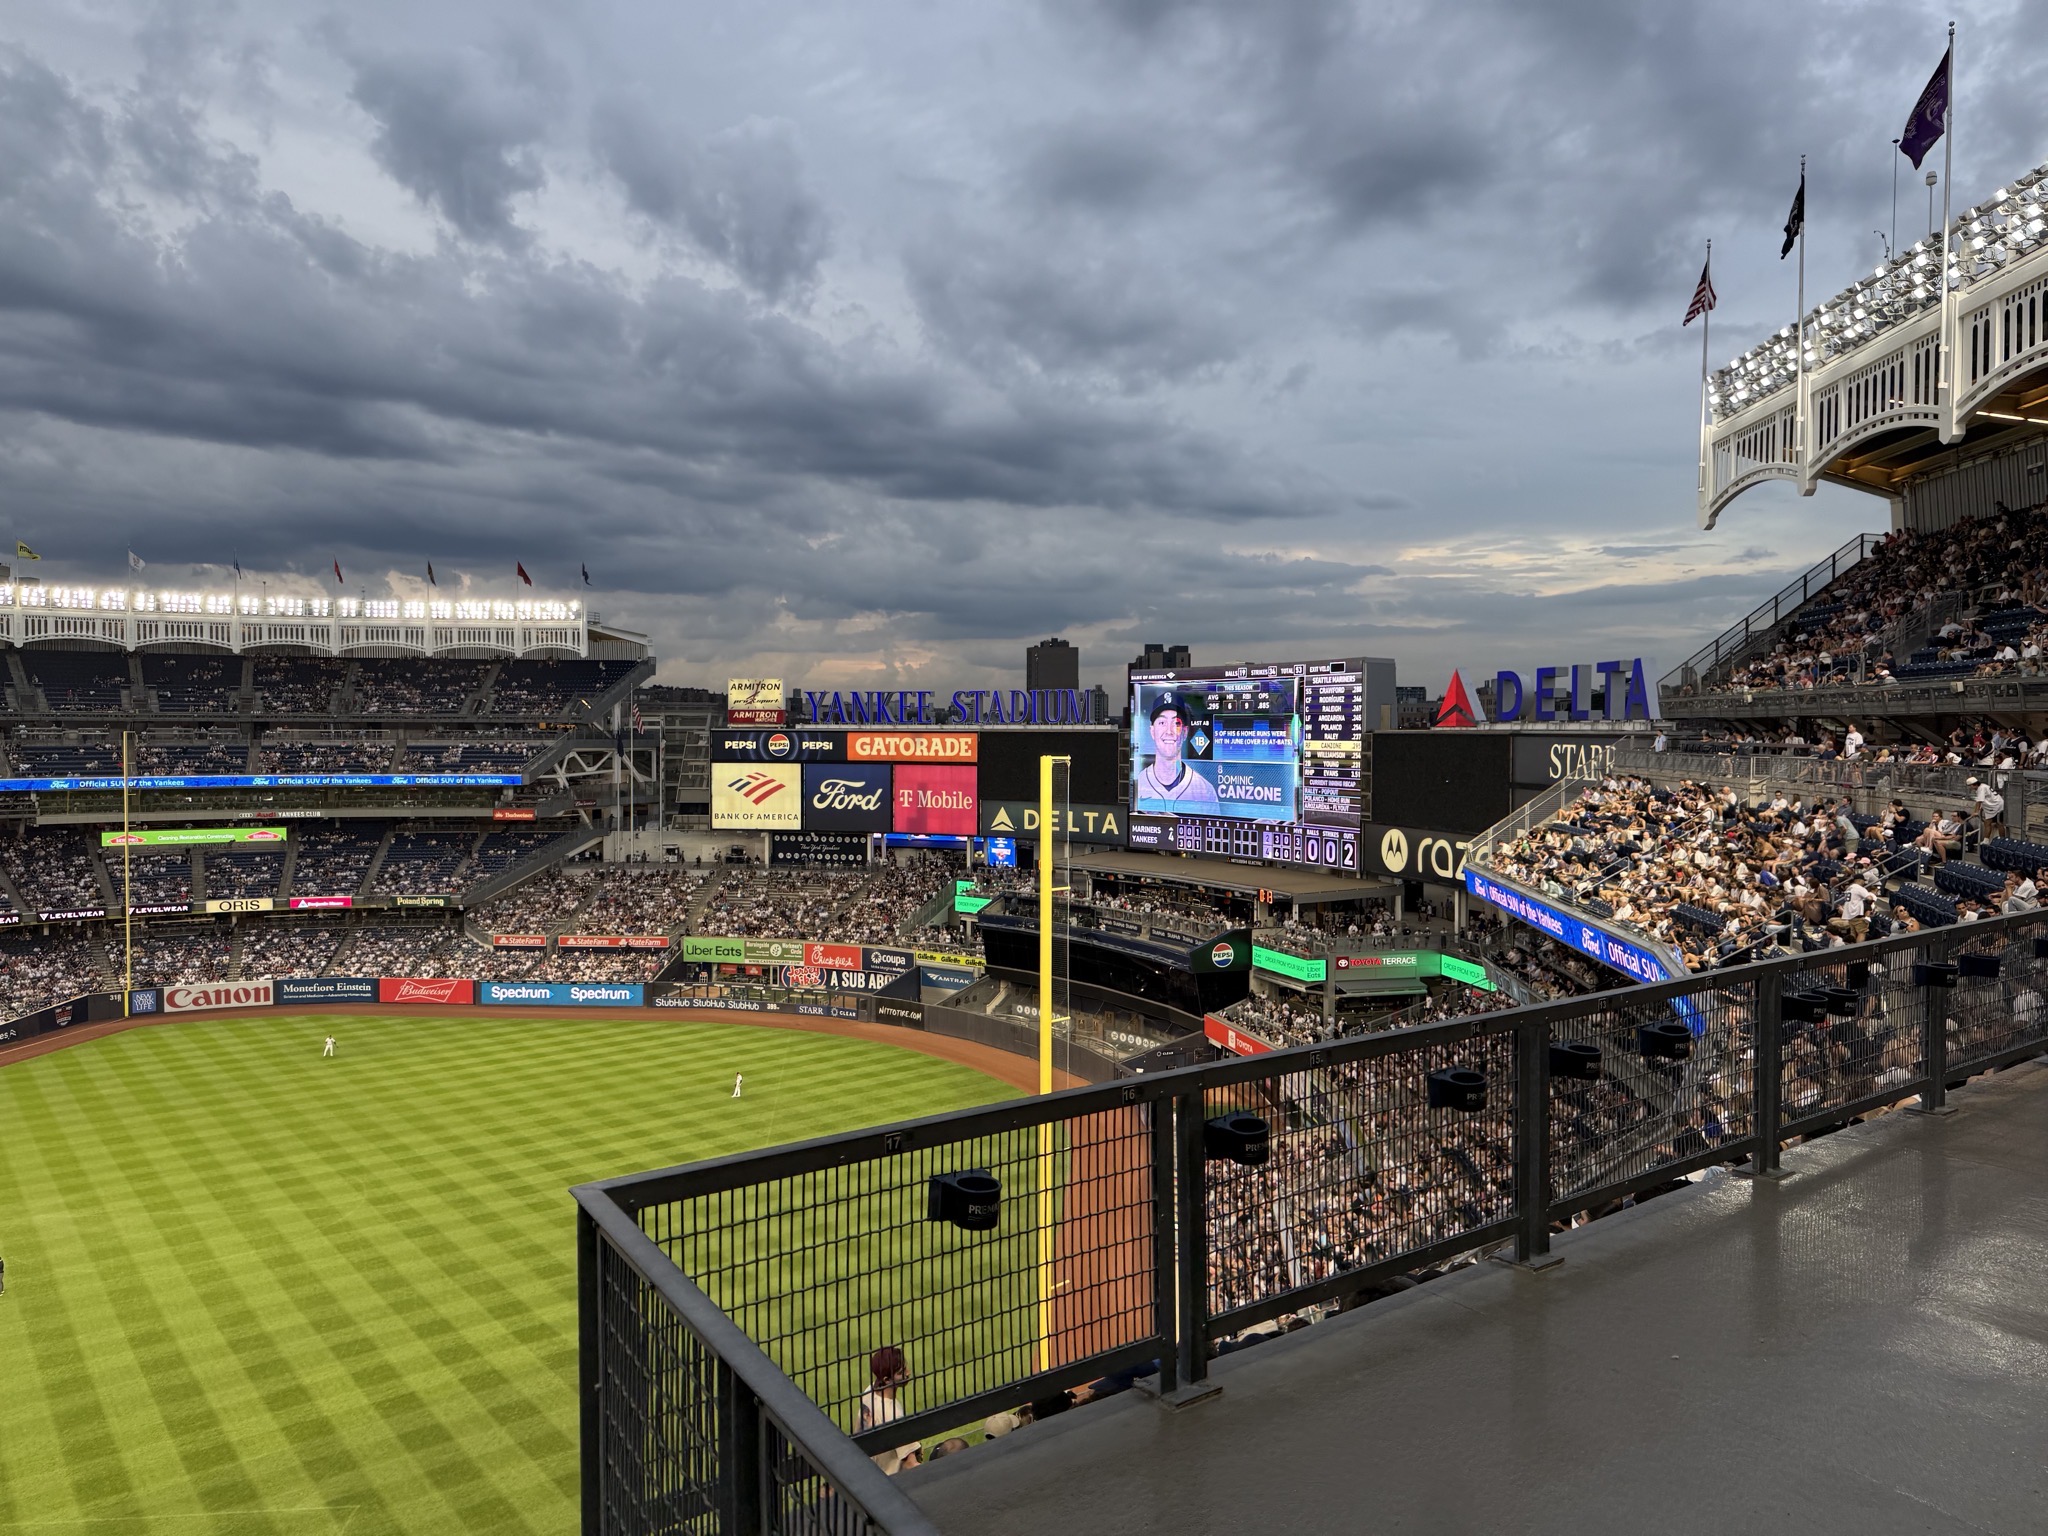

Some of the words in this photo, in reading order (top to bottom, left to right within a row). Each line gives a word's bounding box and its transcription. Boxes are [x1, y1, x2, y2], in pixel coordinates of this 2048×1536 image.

[1497, 658, 1654, 721] DELTA
[1319, 695, 1345, 703] RODRÍGUEZ
[804, 691, 935, 725] YANKEE
[952, 689, 1097, 724] STADIUM
[725, 741, 756, 750] PEPSI
[802, 742, 833, 750] PEPSI
[1195, 736, 1204, 746] 1B
[855, 737, 972, 757] GATORADE
[1217, 764, 1222, 774] 8
[50, 780, 70, 788] Ford
[79, 780, 108, 788] Official
[153, 779, 185, 787] Yankees
[252, 777, 269, 785] Ford
[278, 777, 304, 785] Official
[322, 777, 330, 785] of
[331, 777, 343, 785] the
[345, 777, 372, 785] Yankees
[392, 777, 408, 785] Ford
[415, 776, 439, 785] Official
[456, 776, 463, 785] of
[465, 776, 476, 785] the
[477, 776, 503, 785] Yankees
[1217, 775, 1254, 785] DOMINIC
[813, 778, 884, 812] Ford
[1217, 785, 1282, 802] CANZONE
[899, 789, 913, 807] T
[917, 790, 973, 810] Mobile
[714, 813, 741, 821] BANK
[742, 813, 755, 821] OF
[756, 812, 799, 821] AMERICA
[1024, 807, 1120, 836] DELTA
[1132, 825, 1161, 834] MARINERS
[1132, 835, 1158, 844] YANKEES
[1308, 839, 1318, 861] 0
[1326, 841, 1336, 863] 0
[1344, 843, 1353, 865] 2
[219, 900, 260, 912] ORIS
[421, 897, 444, 906] Spring
[49, 910, 105, 920] LEVELWEAR
[134, 905, 189, 915] LEVELWEAR
[1489, 886, 1507, 908] Official
[1508, 896, 1519, 912] SUV
[1537, 908, 1563, 936] Yankees
[686, 944, 713, 958] Uber
[715, 946, 742, 957] Eats
[1581, 927, 1600, 956] Ford
[1608, 942, 1641, 975] Official
[882, 954, 906, 966] coupa
[1350, 958, 1381, 966] TOYOTA
[1382, 956, 1417, 966] TERRACE
[787, 966, 819, 976] Jersey
[830, 971, 838, 986] A
[842, 972, 866, 988] SUB
[1706, 978, 1712, 987] 12
[283, 983, 334, 993] Montefiore
[404, 984, 451, 997] Budweiser
[491, 986, 550, 1000] Spectrum
[166, 983, 271, 1008] Canon
[570, 987, 630, 1000] Spectrum
[655, 997, 690, 1008] StubHub
[692, 999, 726, 1009] StubHub
[727, 1000, 760, 1011] StubHub
[1600, 1000, 1607, 1009] 13
[799, 1006, 823, 1015] STARR
[879, 1007, 922, 1021] NITTOTIRE.COM
[1472, 1023, 1480, 1033] 14
[1237, 1039, 1253, 1053] TOYOTA
[1311, 1054, 1320, 1064] 15
[1123, 1089, 1135, 1100] 16
[886, 1136, 900, 1150] 17
